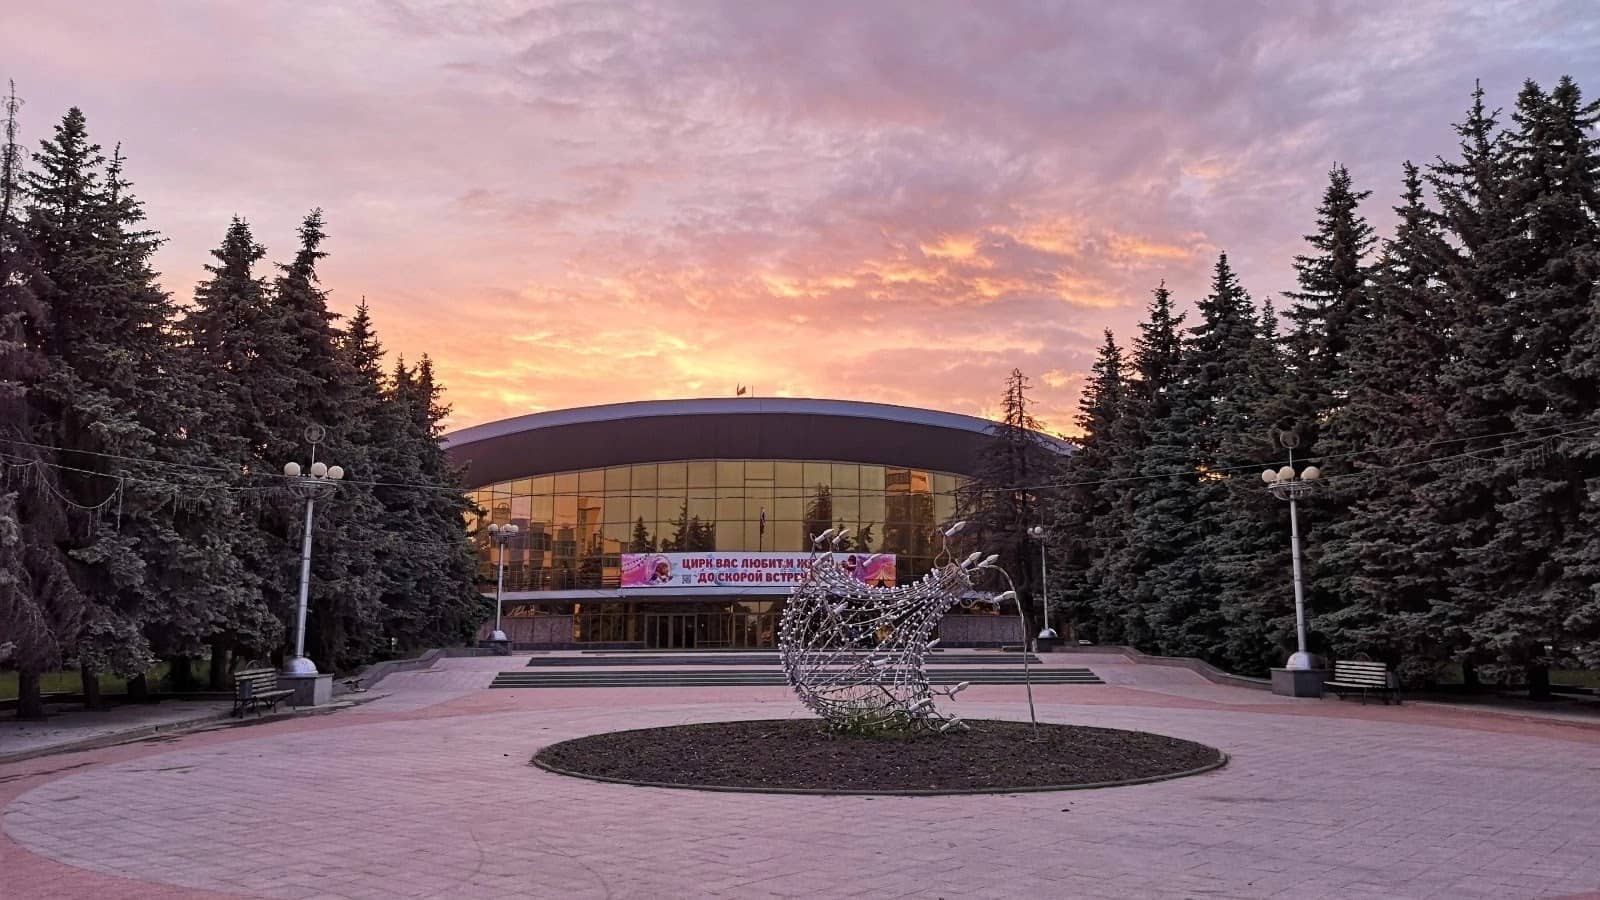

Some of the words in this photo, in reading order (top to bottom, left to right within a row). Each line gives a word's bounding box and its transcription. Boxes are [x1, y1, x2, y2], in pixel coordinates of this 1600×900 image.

[682, 558, 713, 570] ЦИРК
[716, 558, 738, 568] ВАС
[741, 558, 784, 568] ЛЮБИТ
[698, 572, 715, 583] ДО
[717, 570, 763, 583] СКОРОЙ
